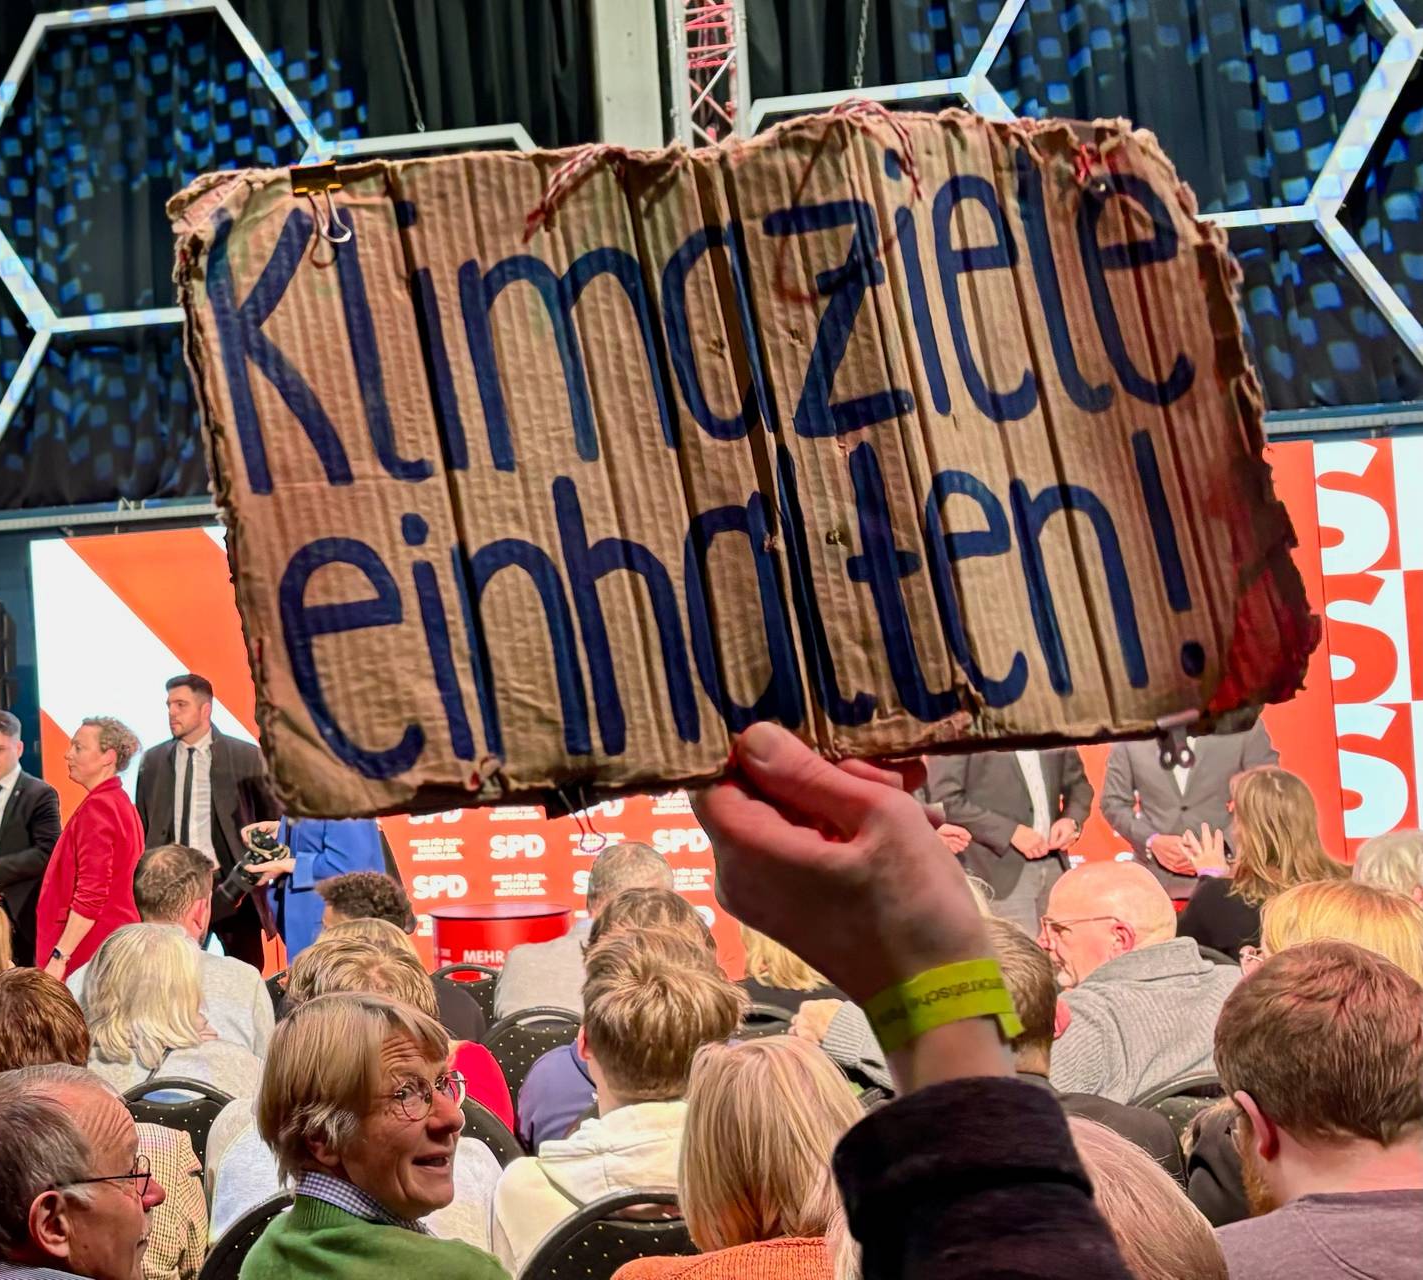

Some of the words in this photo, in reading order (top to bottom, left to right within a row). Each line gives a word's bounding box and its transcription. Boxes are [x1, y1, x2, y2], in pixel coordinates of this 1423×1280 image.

[206, 148, 1194, 495] Klimaziele
[278, 428, 1208, 780] einhalten!
[489, 833, 546, 859] SPD
[652, 828, 712, 855] SPD
[412, 873, 469, 900] SPD
[462, 948, 505, 964] MEHR
